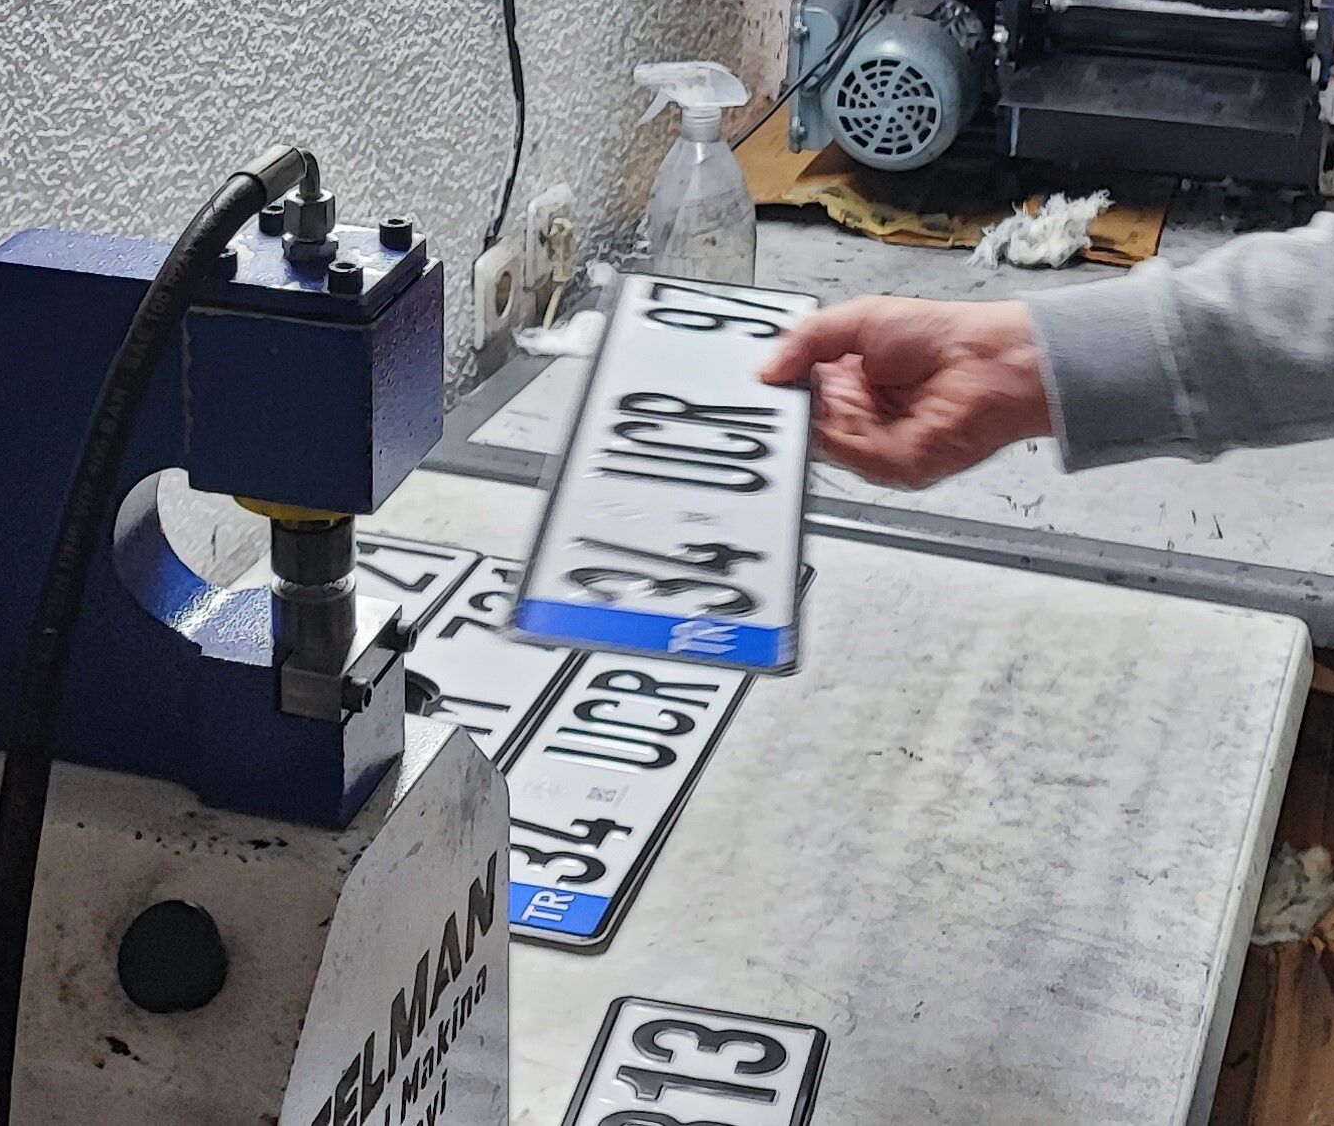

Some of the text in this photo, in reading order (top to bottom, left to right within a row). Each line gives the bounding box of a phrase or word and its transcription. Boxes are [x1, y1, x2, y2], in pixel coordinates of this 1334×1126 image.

[645, 282, 794, 339] 97
[597, 391, 782, 493] UCR
[567, 536, 765, 617] 34
[509, 669, 720, 923] TR 34 UCR
[400, 963, 488, 1126] Makina
